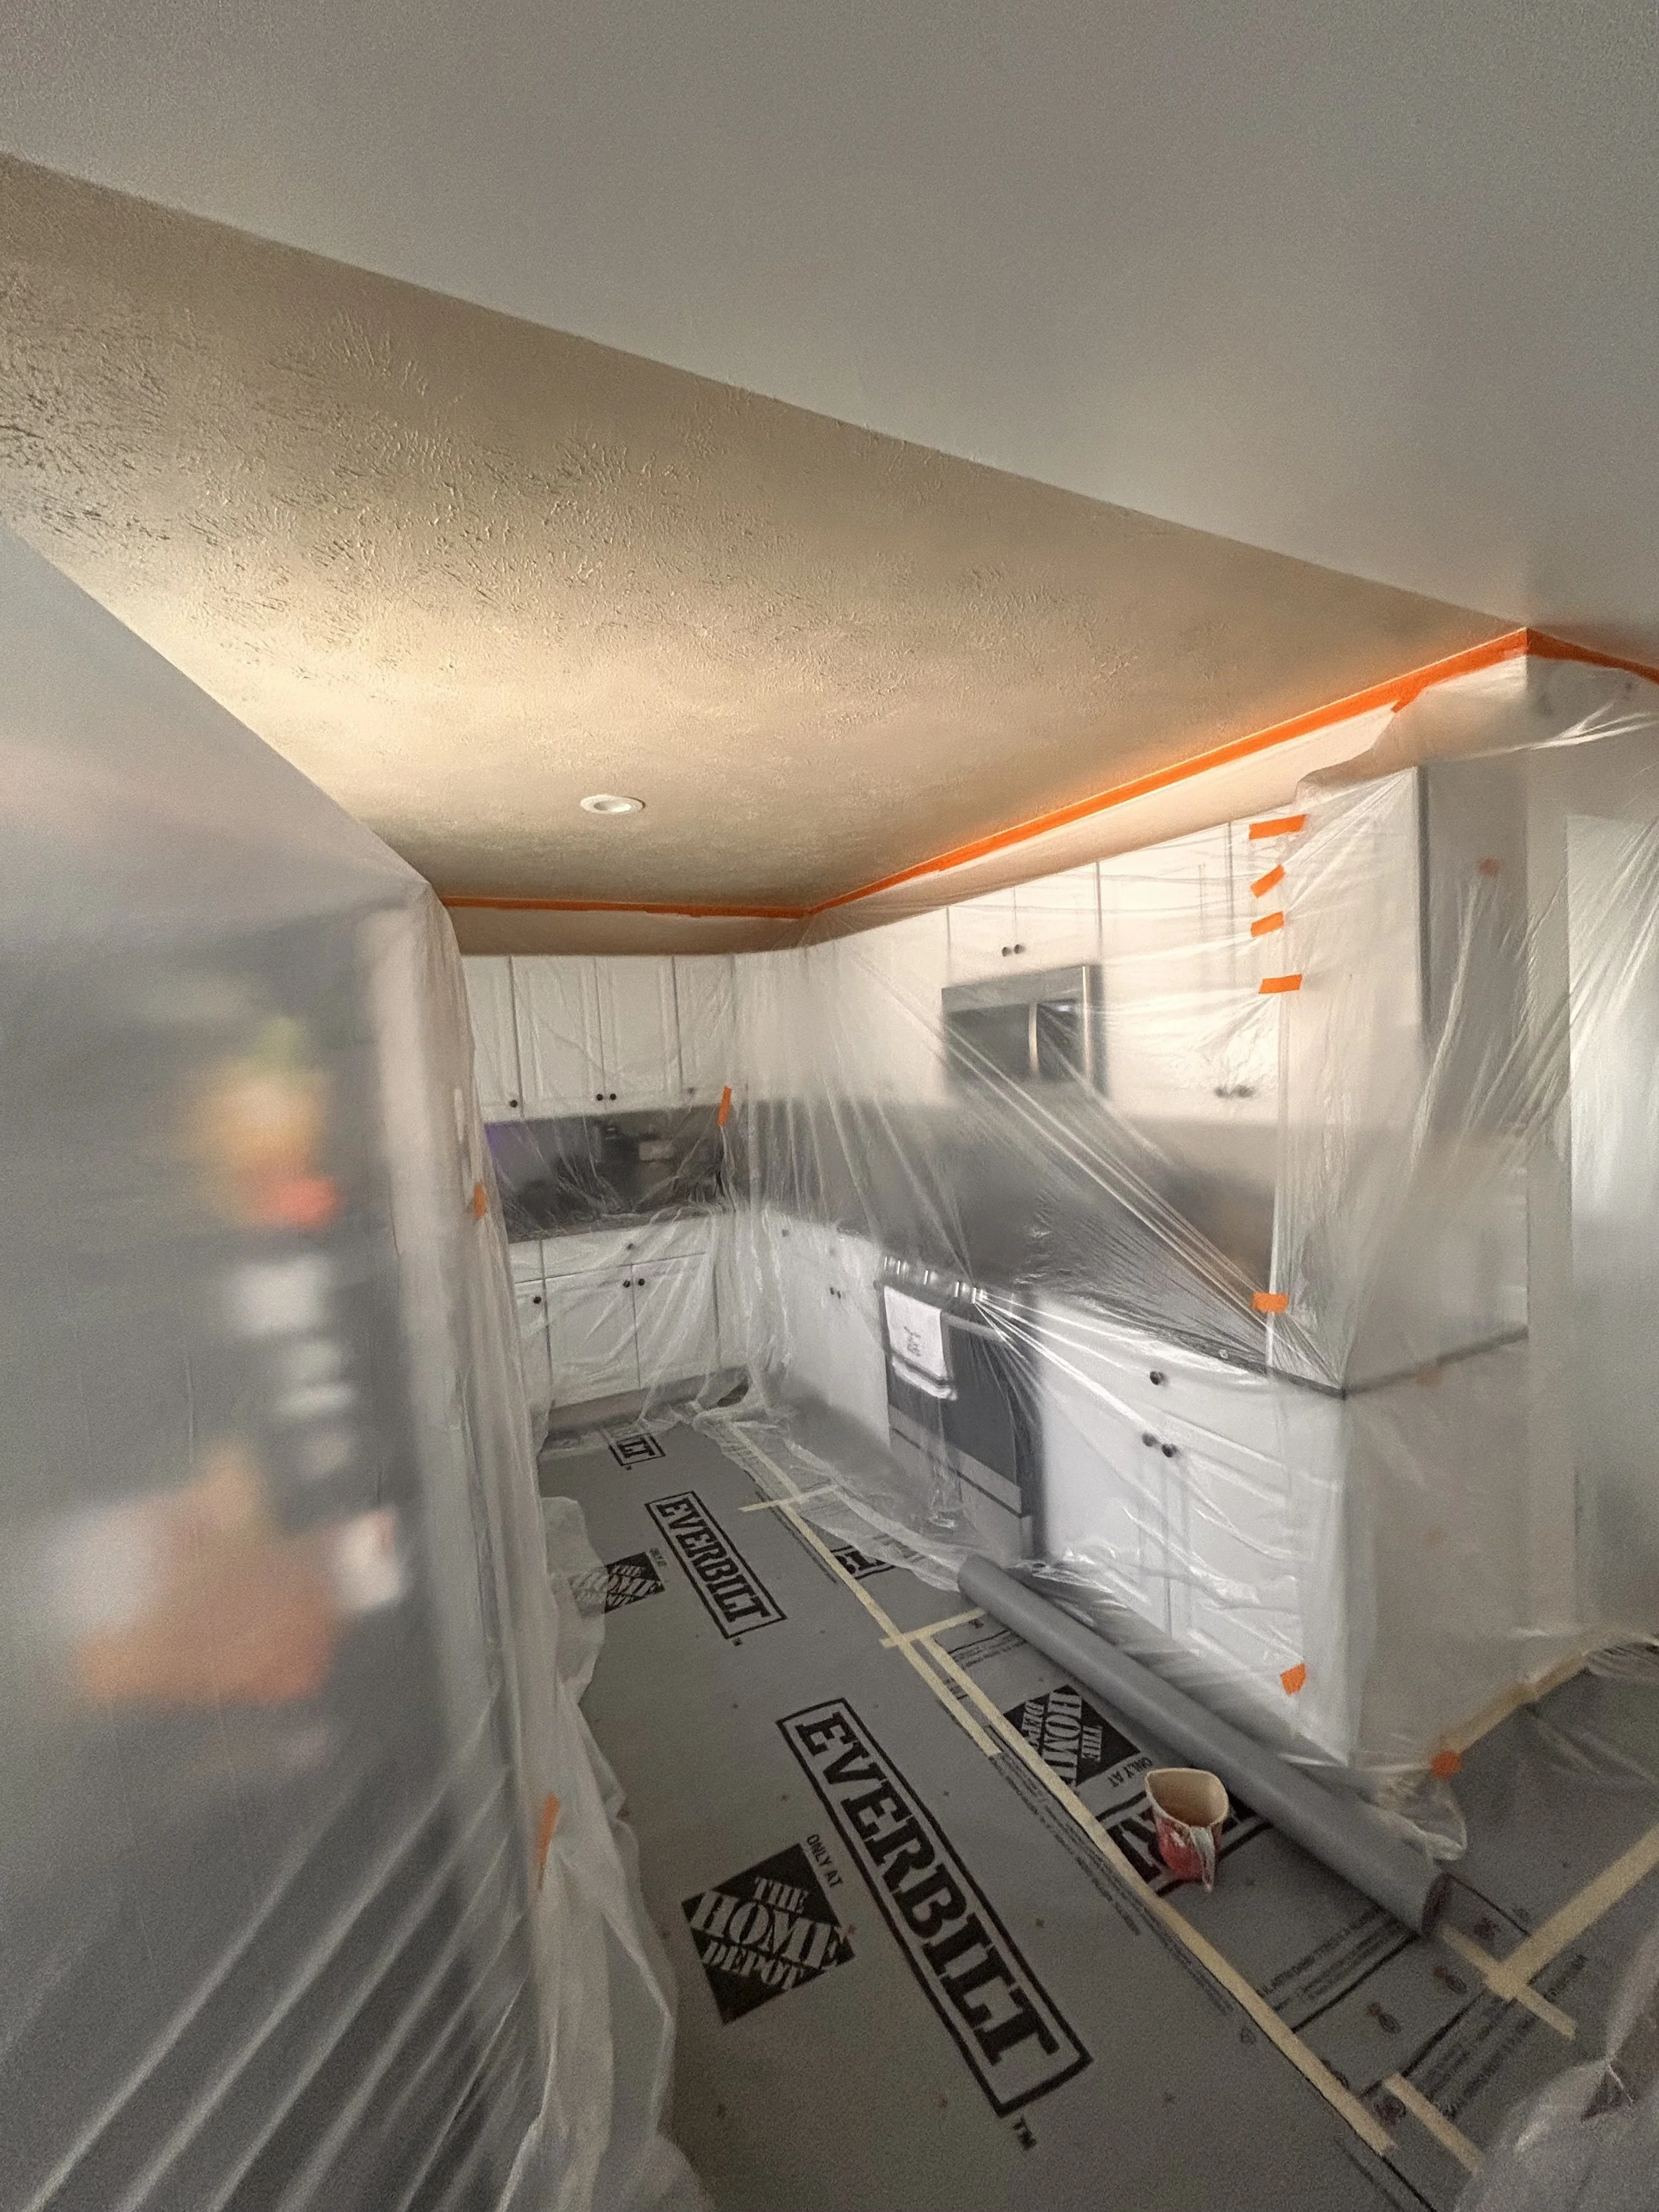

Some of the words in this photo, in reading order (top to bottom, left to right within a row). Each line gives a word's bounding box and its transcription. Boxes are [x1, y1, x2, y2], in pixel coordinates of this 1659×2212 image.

[656, 1498, 771, 1623] EVERBILT
[1107, 1771, 1124, 1787] AT
[807, 1834, 832, 1867] ONLY
[826, 1869, 844, 1887] AT
[754, 1876, 809, 1914] THE
[795, 1711, 1059, 2065] EVERBILT
[690, 1891, 843, 1974] HOME
[701, 1939, 806, 1991] DEPOT
